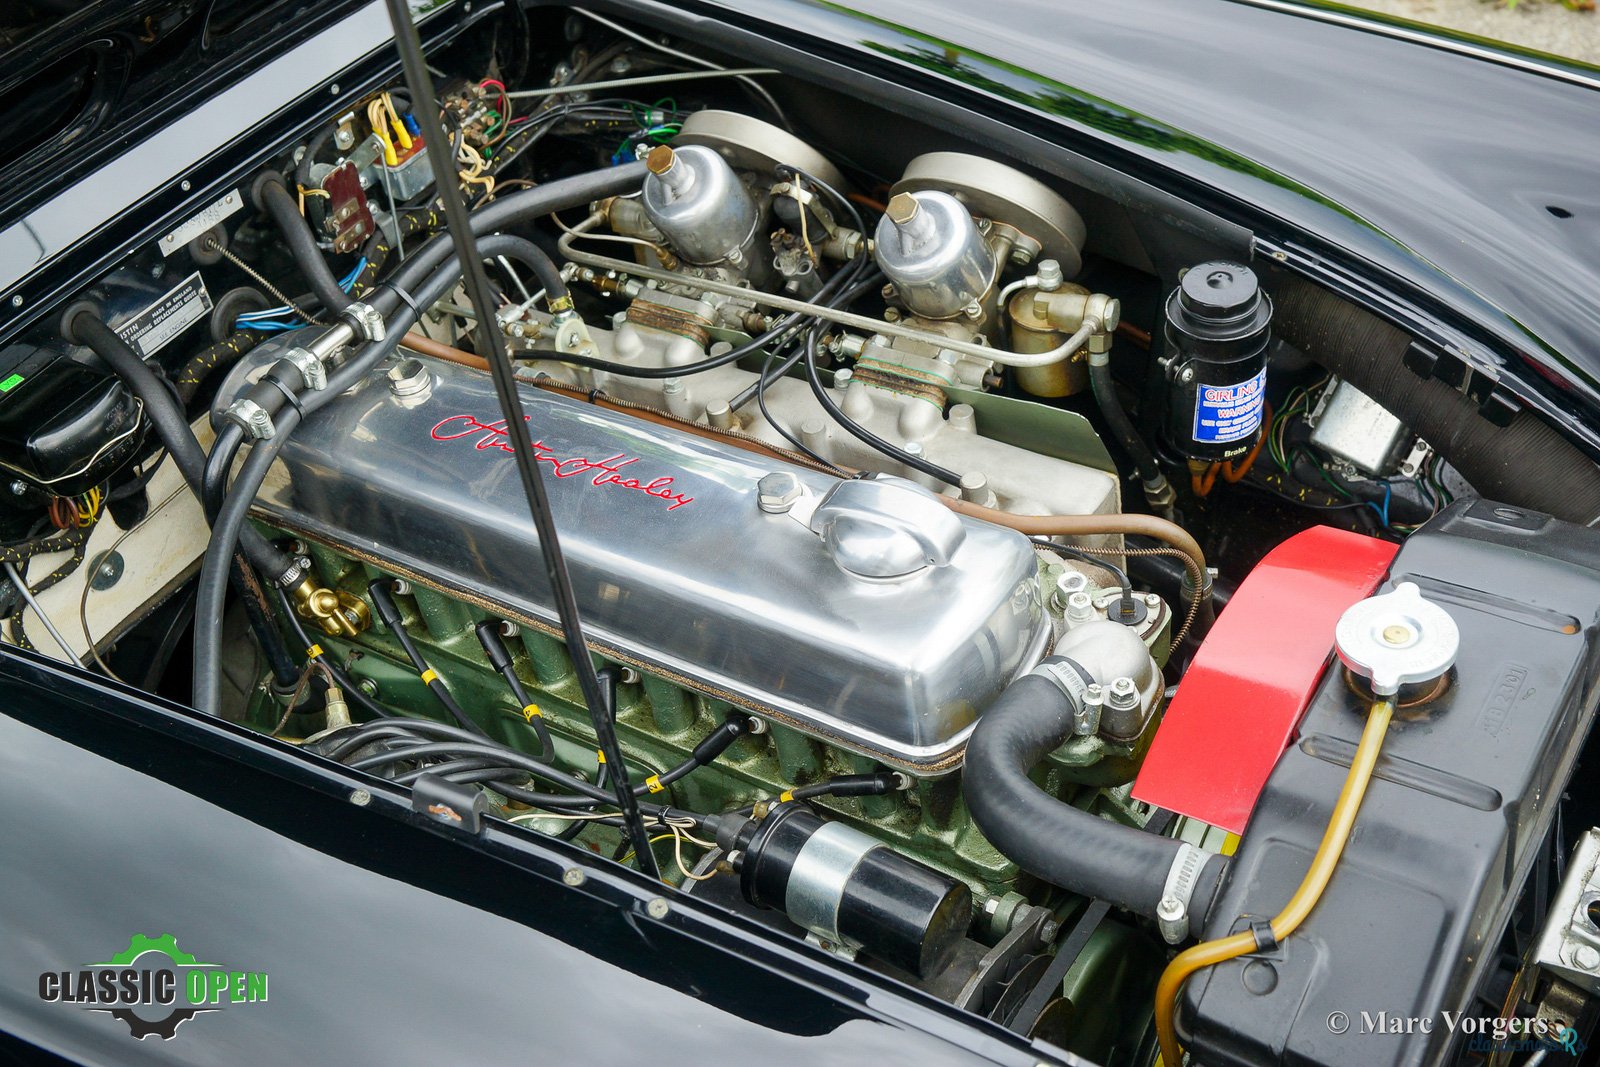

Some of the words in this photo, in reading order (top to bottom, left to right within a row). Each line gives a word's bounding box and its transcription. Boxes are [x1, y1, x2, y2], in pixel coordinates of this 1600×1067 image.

[120, 323, 139, 340] STIN
[151, 306, 165, 318] MADE
[172, 286, 193, 302] ENGLAND
[153, 301, 184, 326] REPLACEMENTS
[1205, 381, 1257, 401] GIRLING
[1224, 446, 1247, 457] Brake
